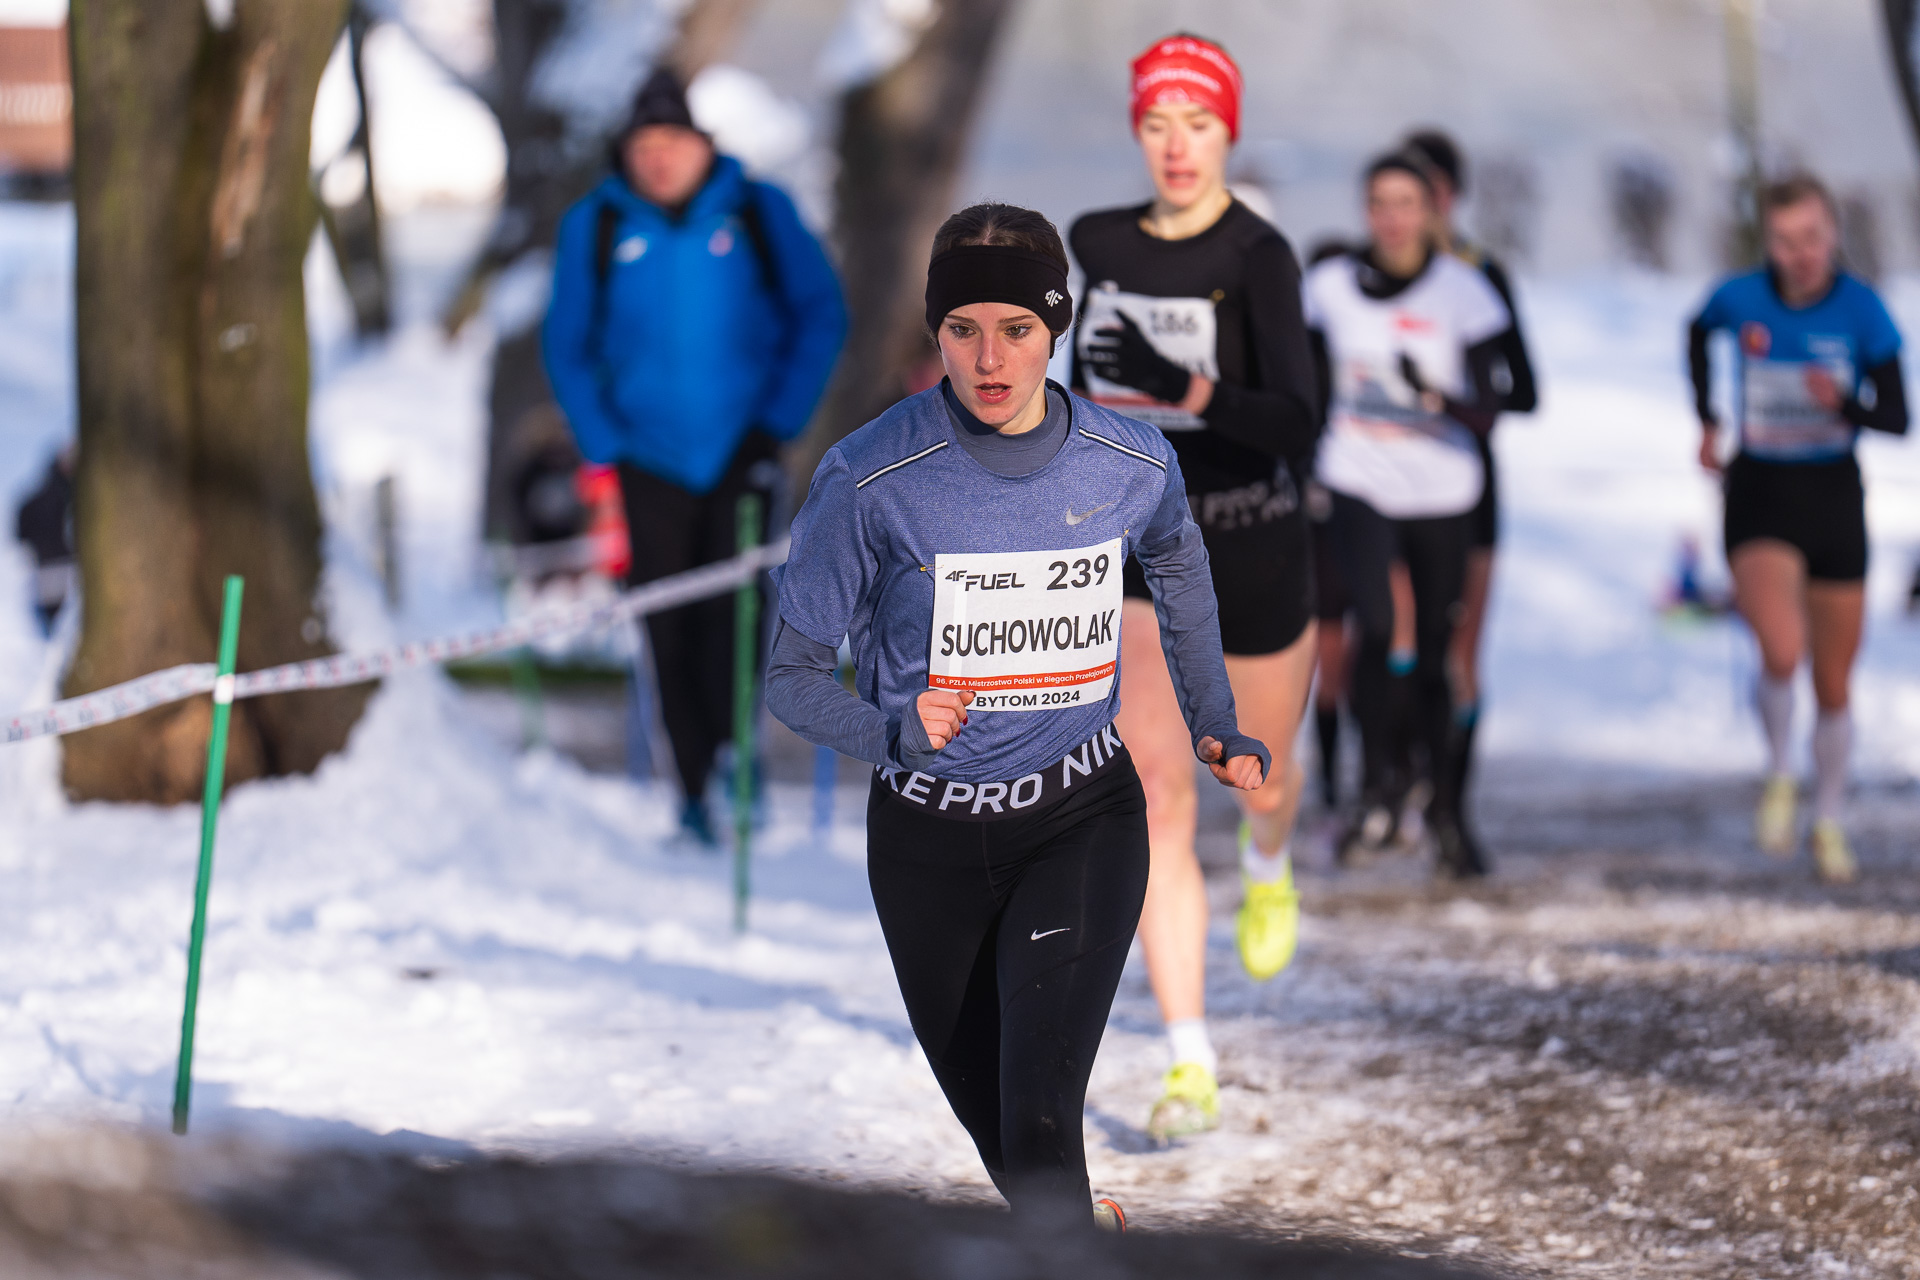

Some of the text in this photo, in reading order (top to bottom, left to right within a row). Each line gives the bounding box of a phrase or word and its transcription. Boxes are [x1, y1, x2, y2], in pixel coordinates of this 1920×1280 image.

[965, 573, 1025, 591] FUEL
[1046, 553, 1109, 591] 239
[940, 609, 1116, 656] SUCHOWOLAK
[968, 679, 1012, 687] Mistrzostwa
[1013, 677, 1035, 685] Polski
[1044, 675, 1074, 684] Biegach
[976, 690, 1081, 707] BYTOM 2024
[876, 723, 1122, 814] KE PRO NIK
